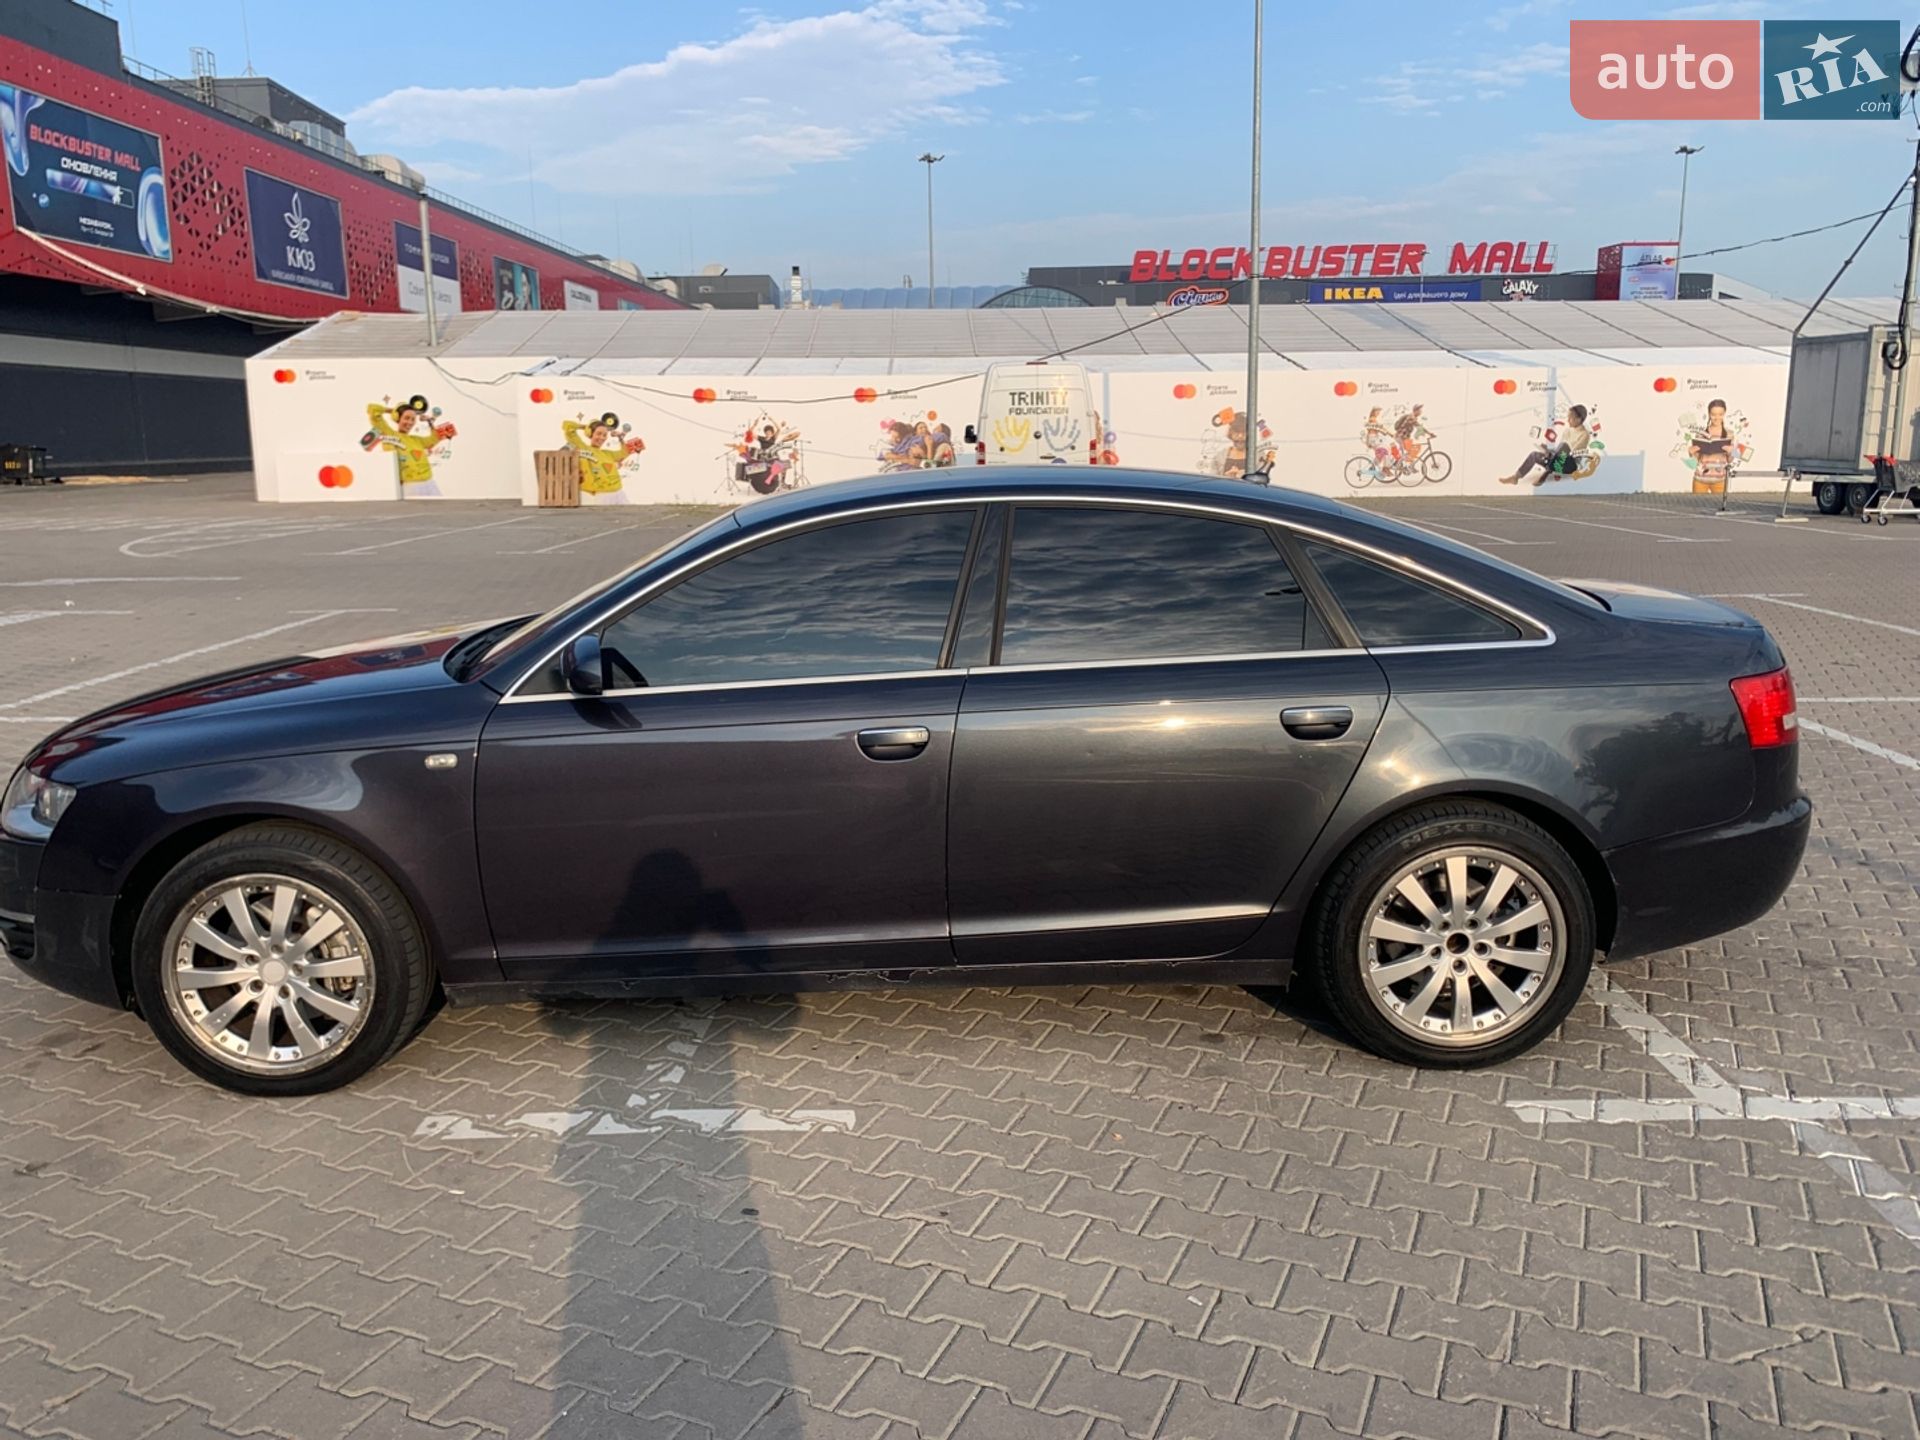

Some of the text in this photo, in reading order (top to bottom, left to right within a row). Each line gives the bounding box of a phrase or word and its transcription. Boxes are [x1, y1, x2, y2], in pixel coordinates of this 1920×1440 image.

[29, 124, 142, 172] BLOCKBUSTER MALL
[60, 156, 118, 181] ОНОВЛЕННЯ
[1130, 241, 1554, 282] BLOCKBUSTER MALL
[1323, 286, 1385, 301] IKEA
[1008, 391, 1069, 406] TRINITY
[1008, 407, 1069, 416] FOUNDATION
[1401, 824, 1507, 849] NEXEN
